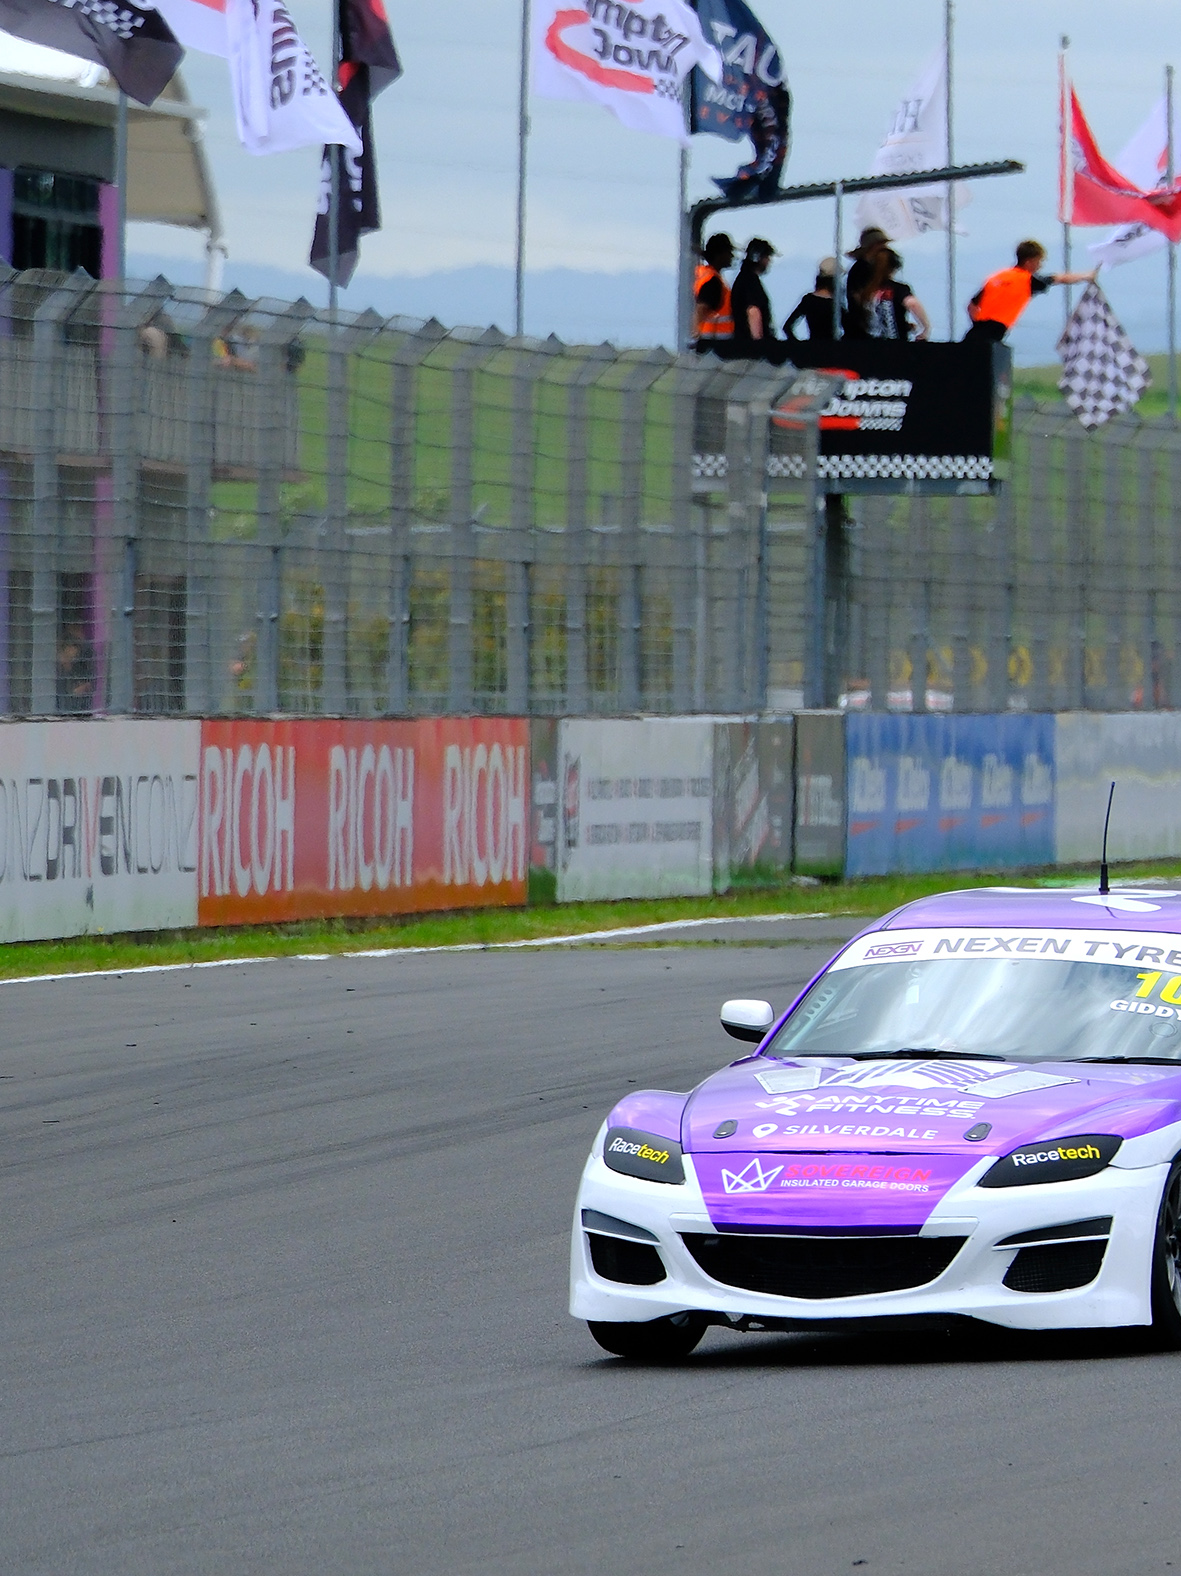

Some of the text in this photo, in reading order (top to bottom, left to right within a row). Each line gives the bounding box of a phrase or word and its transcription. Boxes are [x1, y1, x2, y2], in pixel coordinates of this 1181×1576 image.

[203, 743, 295, 898] RICOH
[328, 743, 415, 891] RICOH
[444, 743, 526, 887] RICOH
[933, 937, 1072, 954] NEXEN
[815, 1094, 985, 1109] ANYTIME
[782, 1125, 939, 1140] SILVERDALE
[608, 1137, 670, 1164] Racetech
[1012, 1145, 1100, 1166] Racetech
[784, 1164, 932, 1182] SOVEREIGN
[780, 1178, 930, 1192] INSULATED GARAGE DOORS
